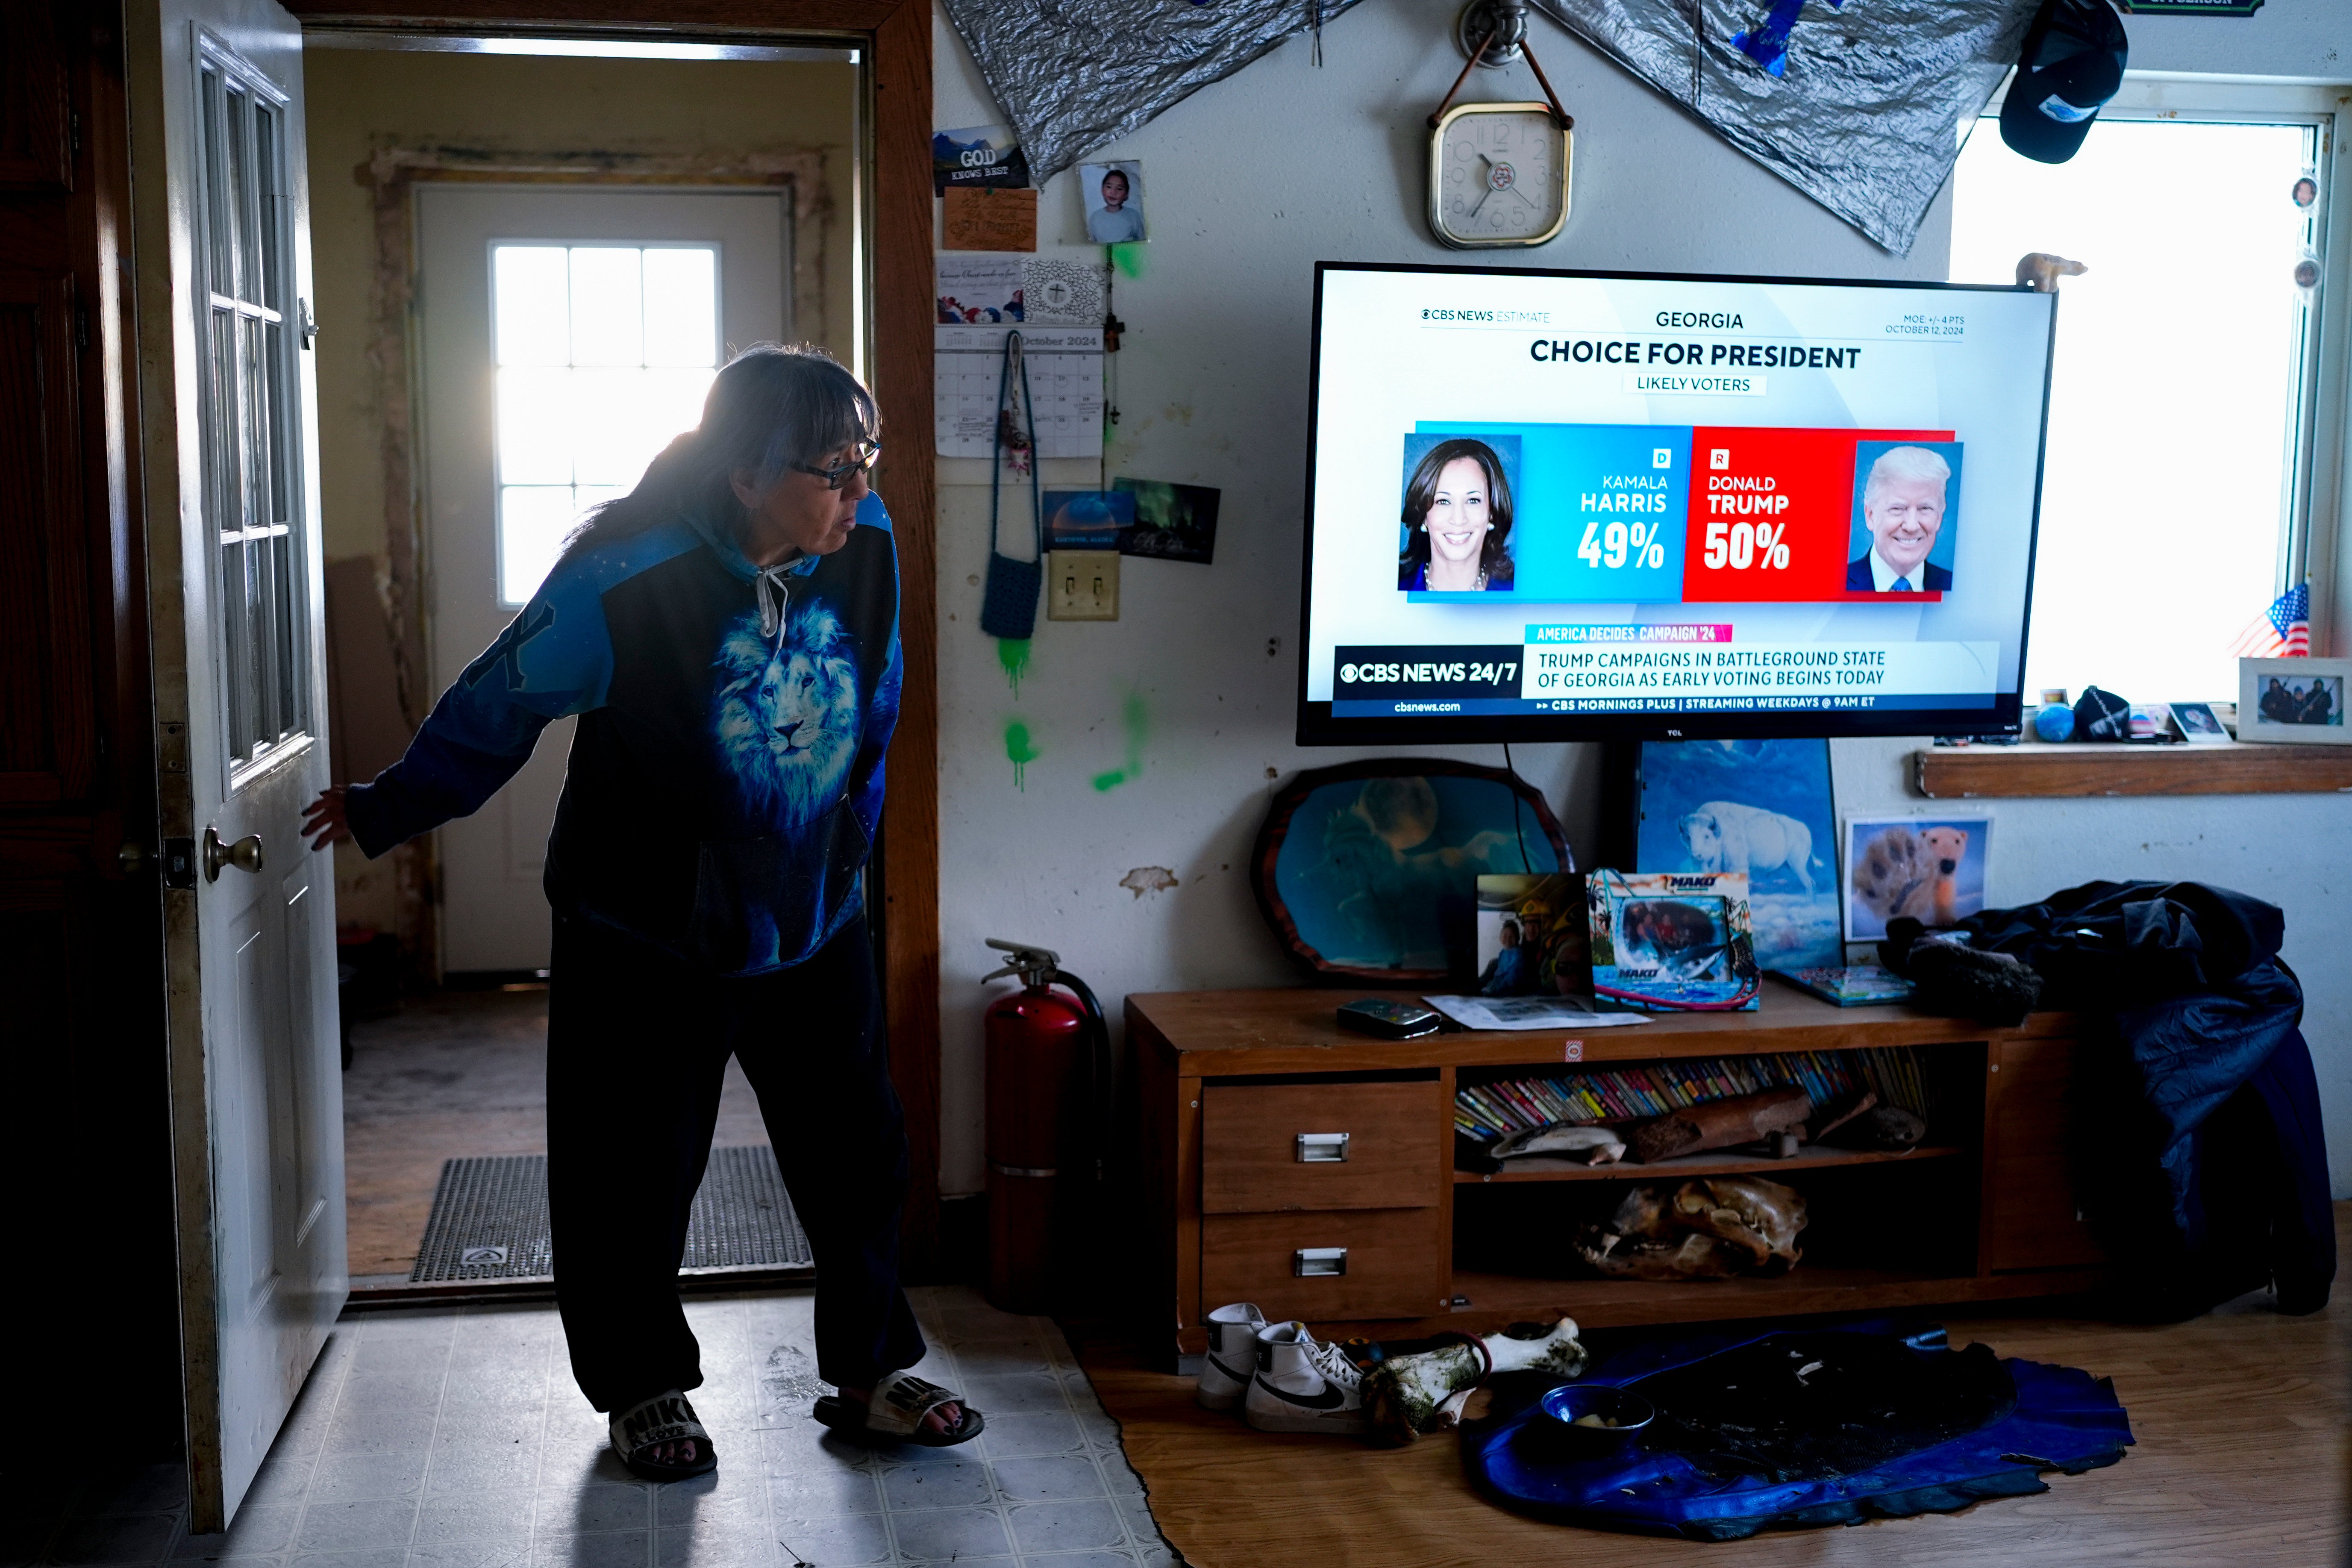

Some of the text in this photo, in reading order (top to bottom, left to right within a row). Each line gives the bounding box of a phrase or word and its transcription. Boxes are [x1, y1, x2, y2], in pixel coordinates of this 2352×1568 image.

[960, 149, 997, 167] GOD
[951, 166, 1009, 180] KNOWS BEST
[1432, 310, 1550, 323] CBS NEWS ESTIMATE
[1656, 312, 1743, 329] GEORGIA
[1886, 325, 1929, 334] OCTOBER
[1932, 327, 1940, 335] 12,
[1067, 337, 1097, 346] 2024
[1531, 340, 1861, 369] CHOICE FOR PRESIDENT
[1638, 377, 1750, 391] LIKELY VOTERS
[1658, 453, 1667, 463] D
[1716, 454, 1724, 465] R
[1602, 476, 1668, 489] KAMALA
[1709, 476, 1776, 491] DONALD
[1581, 493, 1667, 512] HARRIS
[1707, 494, 1789, 514] TRUMP
[1577, 522, 1664, 568] 49%
[1704, 522, 1790, 570] 50%
[1537, 627, 1715, 641] AMERICA DECIDES CAMPAIGN '24
[1539, 651, 1885, 668] TRUMP CAMPAIGNS IN BATTLEGROUND STATE
[1358, 662, 1517, 685] CBS NEWS 24/7
[1538, 671, 1885, 687] OF GEORGIA AS EARLY VOTING BEGINS TODAY
[1394, 702, 1460, 712] cbsnews.com
[1552, 700, 1575, 711] CBS
[1578, 699, 1643, 710] MORNINGS
[1646, 698, 1676, 709] PLUS
[1685, 697, 1753, 709] STREAMING
[1757, 697, 1819, 708] WEEKDAYS
[1822, 697, 1831, 709] @
[1834, 696, 1858, 708] 9AM
[1861, 696, 1875, 707] ET
[1670, 877, 1716, 886] MAKO
[1619, 968, 1659, 977] MAKO
[645, 1425, 685, 1442] LOVE
